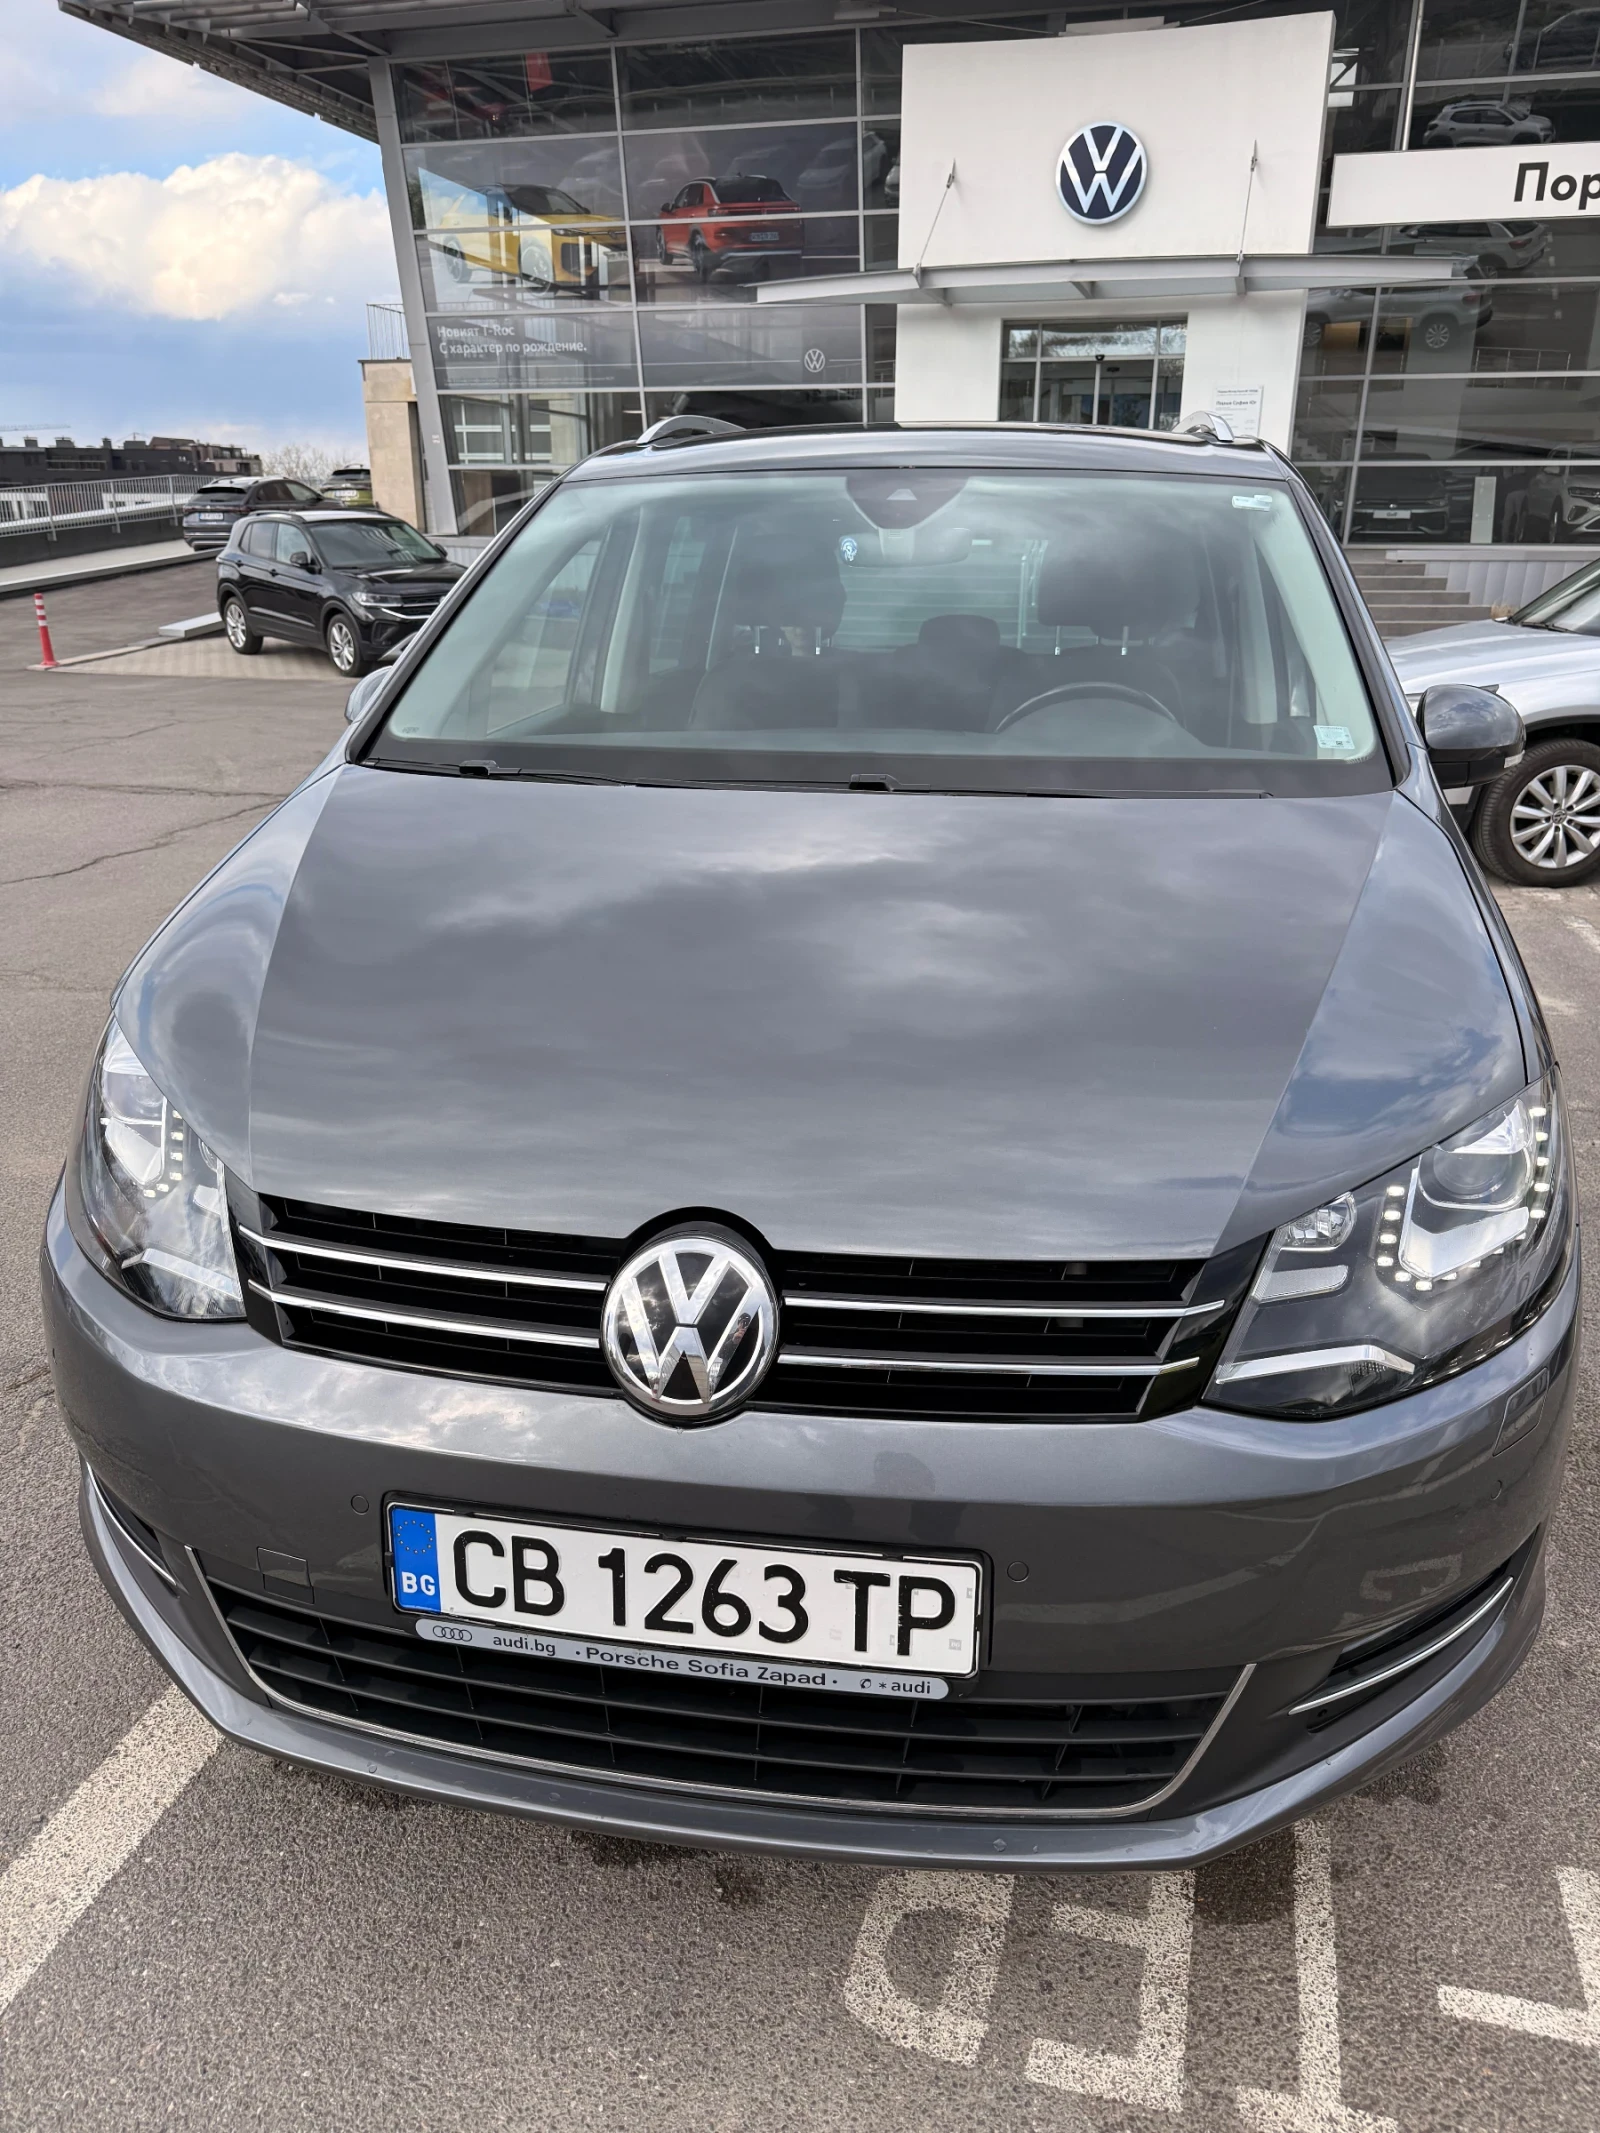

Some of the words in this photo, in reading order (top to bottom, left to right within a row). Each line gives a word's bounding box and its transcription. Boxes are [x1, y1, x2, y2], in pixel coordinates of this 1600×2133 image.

[1513, 161, 1600, 210] Пор
[437, 326, 479, 338] Новият
[483, 324, 515, 336] T-Roc
[439, 342, 448, 354] С
[450, 343, 502, 357] характер
[505, 343, 520, 353] по
[523, 341, 588, 357] рождение.
[401, 1571, 436, 1596] BG
[453, 1529, 565, 1617] CB
[597, 1546, 809, 1644] 1263
[834, 1569, 956, 1656] TP
[493, 1634, 556, 1657] audi.bg
[586, 1647, 679, 1670] Porsche
[688, 1658, 749, 1679] Sofia
[757, 1666, 826, 1686] Zapad
